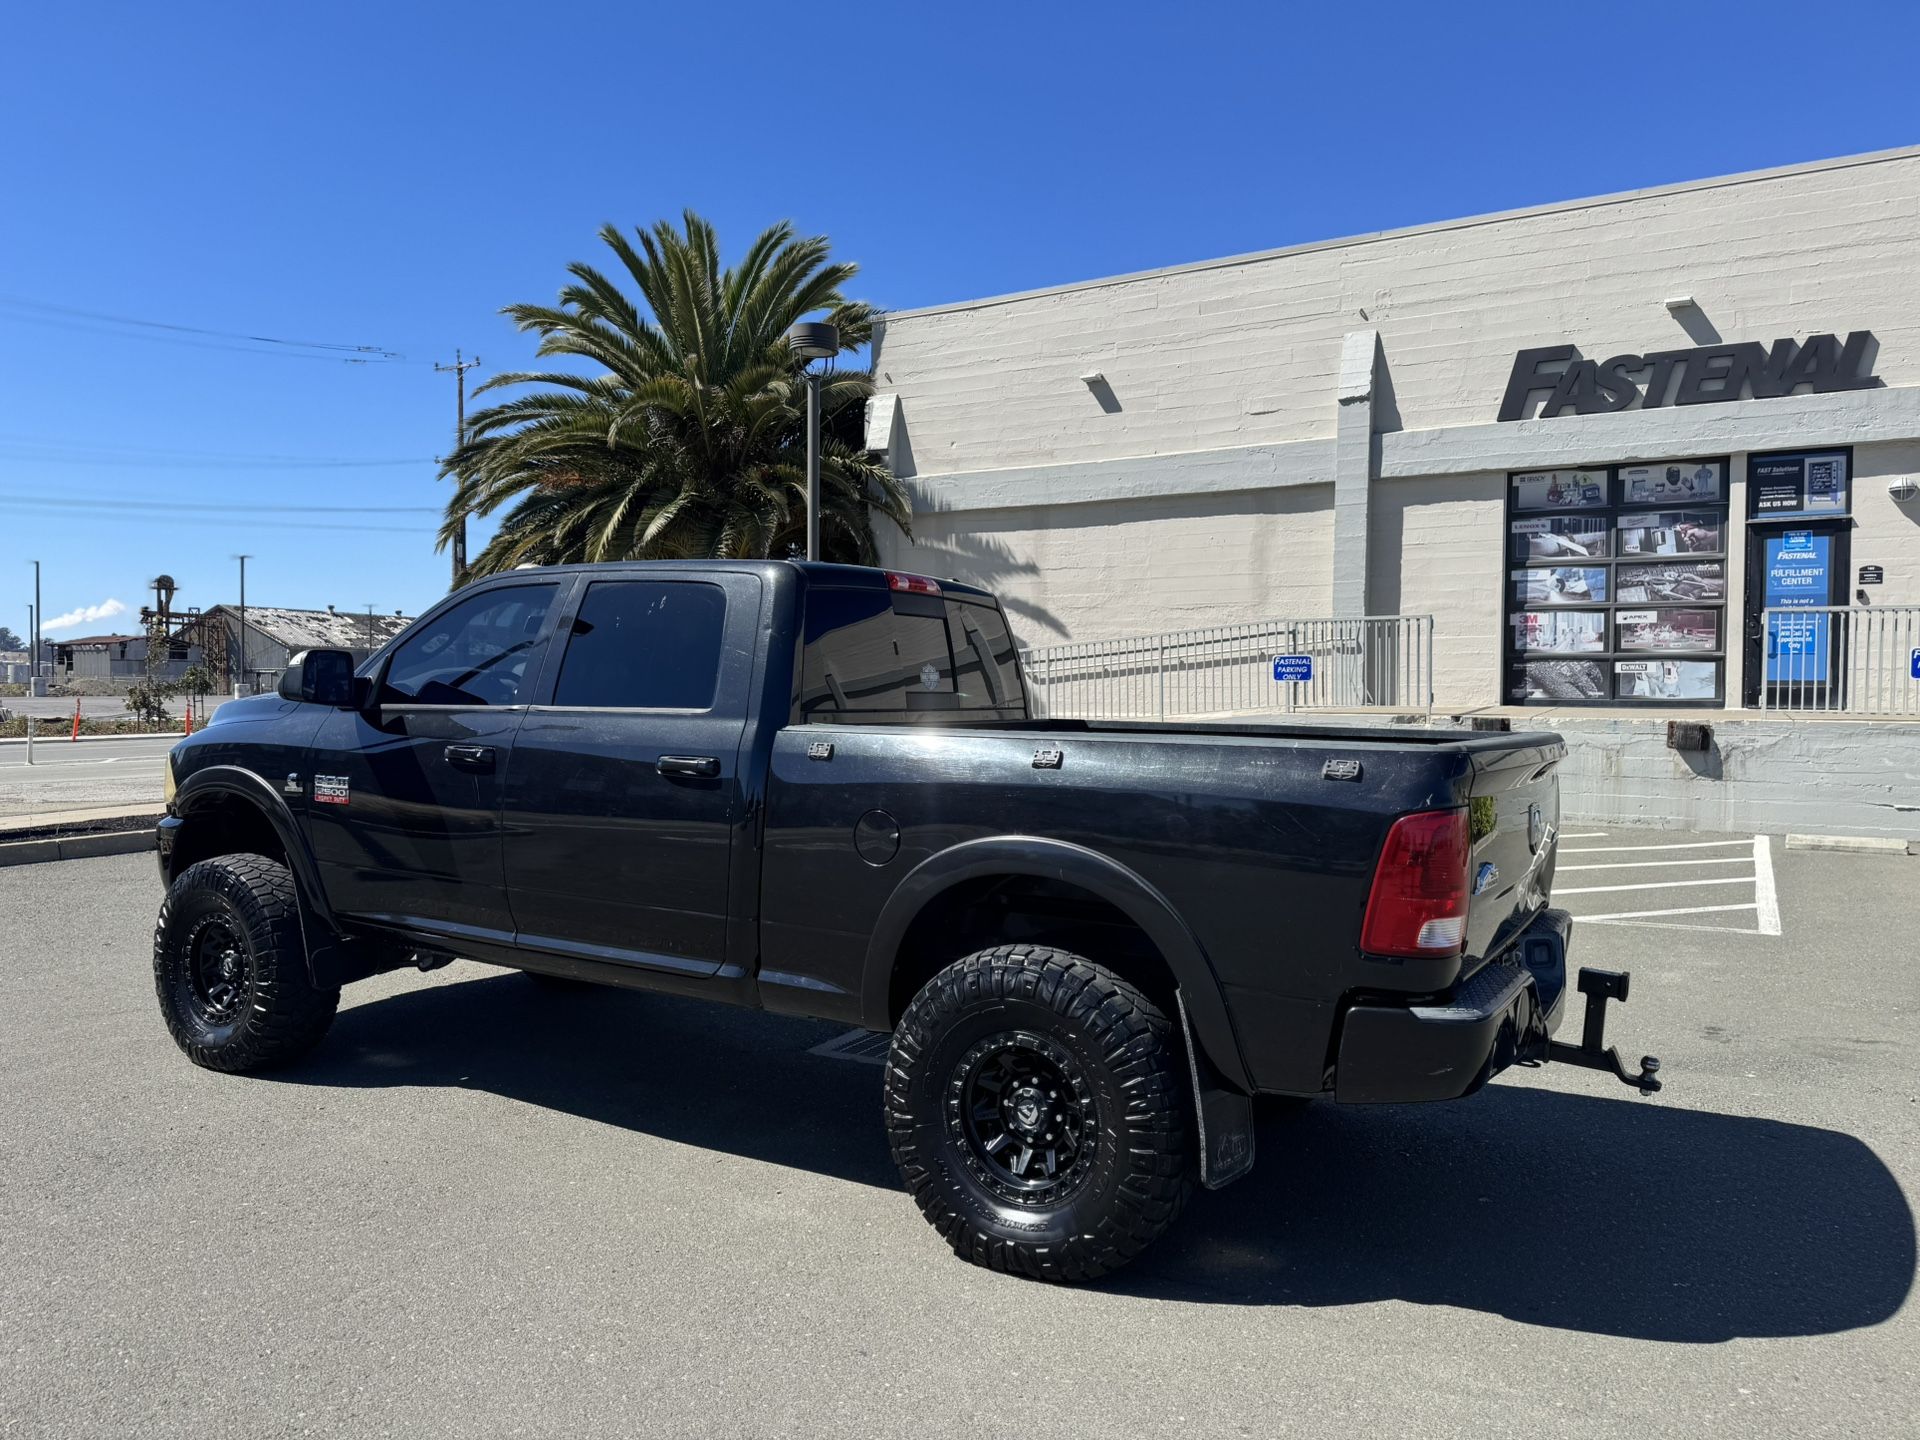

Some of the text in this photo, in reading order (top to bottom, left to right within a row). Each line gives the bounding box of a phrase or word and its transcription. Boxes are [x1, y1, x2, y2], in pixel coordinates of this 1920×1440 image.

[1497, 330, 1880, 422] FASTENAL
[1777, 551, 1817, 560] FASTENAL
[1770, 567, 1824, 577] FULFILLMENT
[1781, 577, 1813, 585] CENTER
[1519, 614, 1538, 624] 3M
[1275, 657, 1311, 665] FASTENAL
[317, 788, 346, 797] 2500
